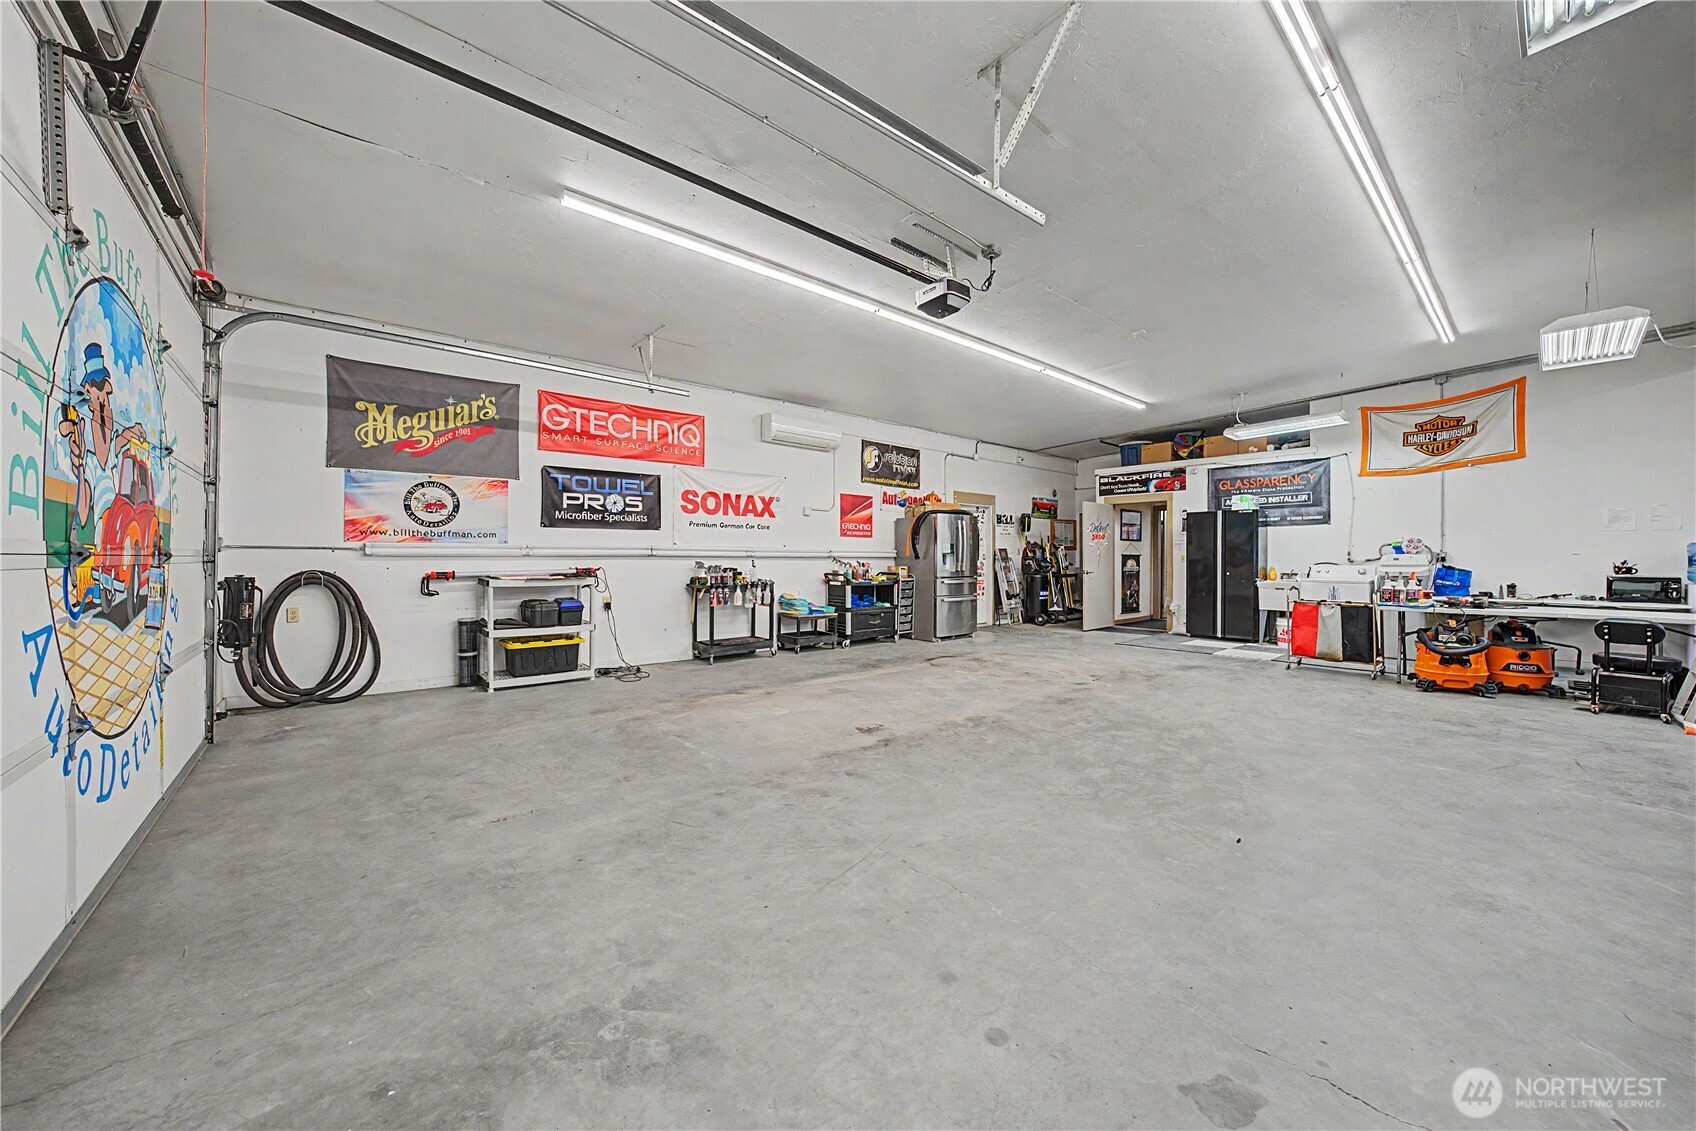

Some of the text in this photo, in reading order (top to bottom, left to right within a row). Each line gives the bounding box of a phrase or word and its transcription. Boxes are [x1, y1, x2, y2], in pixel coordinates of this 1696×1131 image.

[8, 320, 51, 521] Bill
[354, 393, 498, 452] Meguiar's
[542, 403, 701, 448] GTECHNIQ
[1422, 419, 1458, 431] MOTOR
[433, 427, 471, 448] since 1901
[542, 431, 701, 457] SMART SURFACE SCIENCE
[550, 473, 654, 496] TOWEL
[1100, 472, 1171, 483] BLACKFIRE
[1219, 473, 1317, 490] GLASSPARENCY
[563, 492, 642, 513] PROS
[680, 489, 776, 518] SONAX
[555, 511, 648, 522] Microfiber Specialists
[688, 521, 718, 529] Premium
[719, 522, 744, 530] German
[757, 523, 770, 531] Care
[358, 529, 497, 539] www.billthebuffman.com
